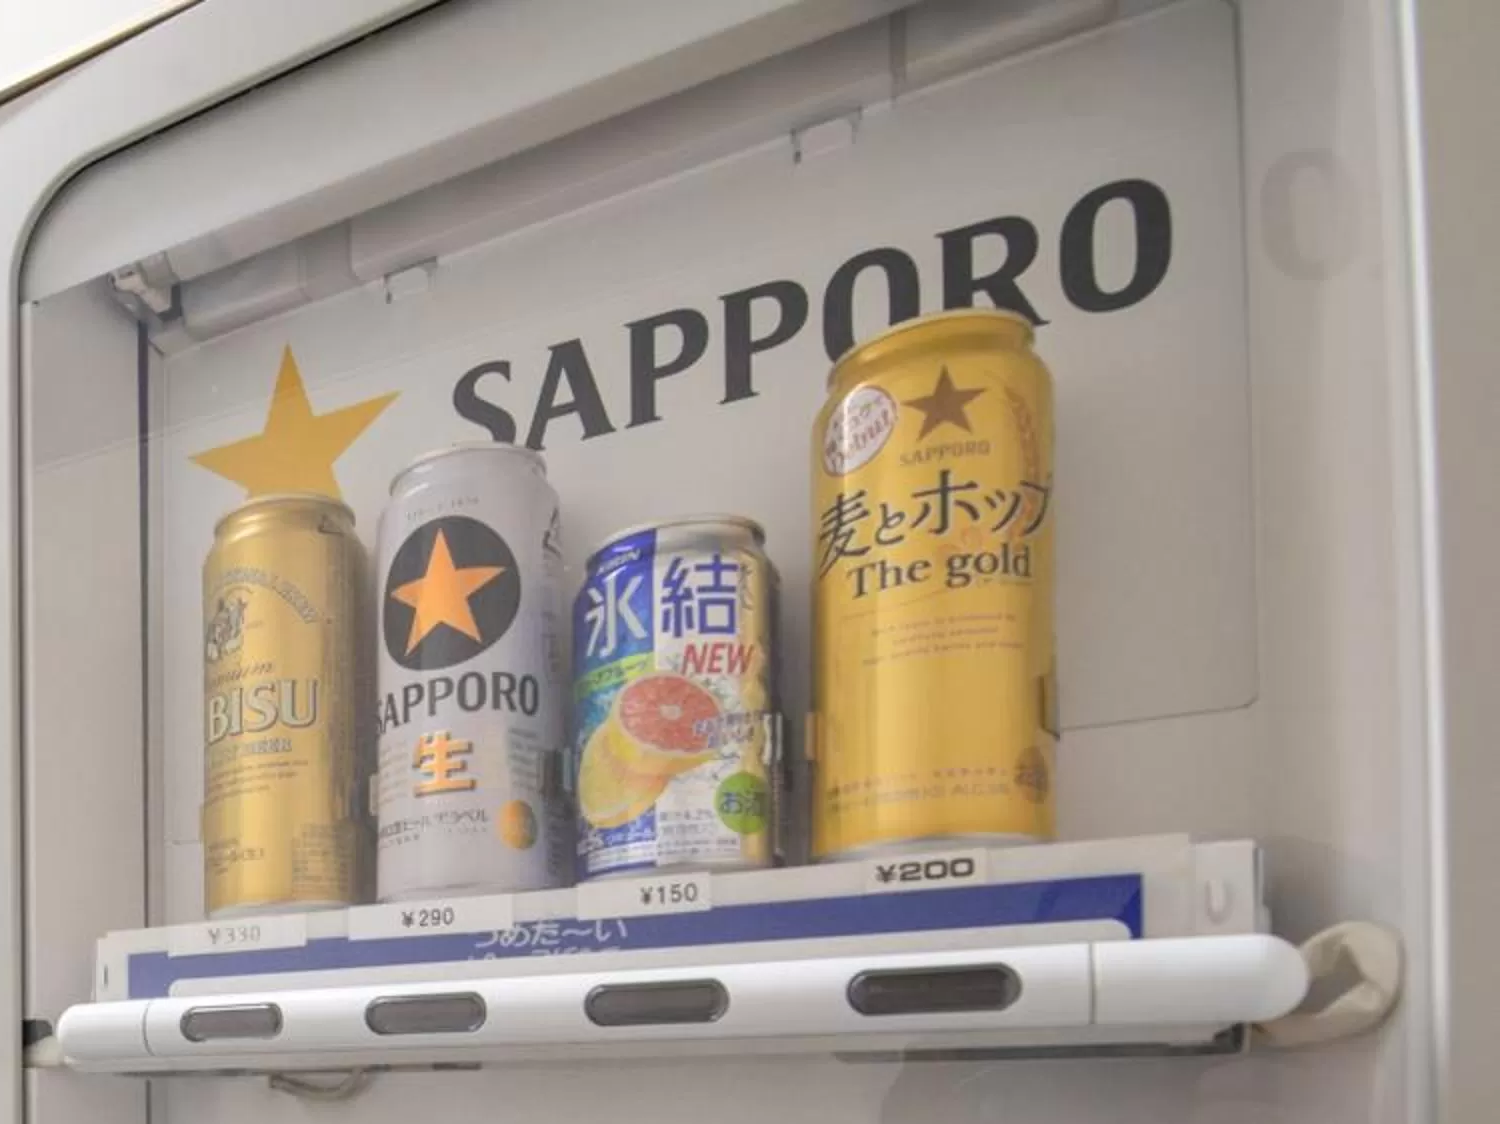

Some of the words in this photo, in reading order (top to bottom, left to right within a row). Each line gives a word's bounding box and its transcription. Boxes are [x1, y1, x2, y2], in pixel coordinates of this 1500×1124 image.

[452, 178, 1173, 450] SAPPORO
[900, 439, 991, 466] SAPPORO
[847, 558, 932, 600] The
[944, 542, 1033, 589] gold
[584, 553, 739, 659] 氷結
[681, 641, 754, 675] NEW
[209, 678, 319, 746] BISU
[411, 731, 477, 799] 生
[876, 857, 975, 883] ¥200
[639, 882, 699, 905] ¥150
[402, 907, 456, 928] ¥290
